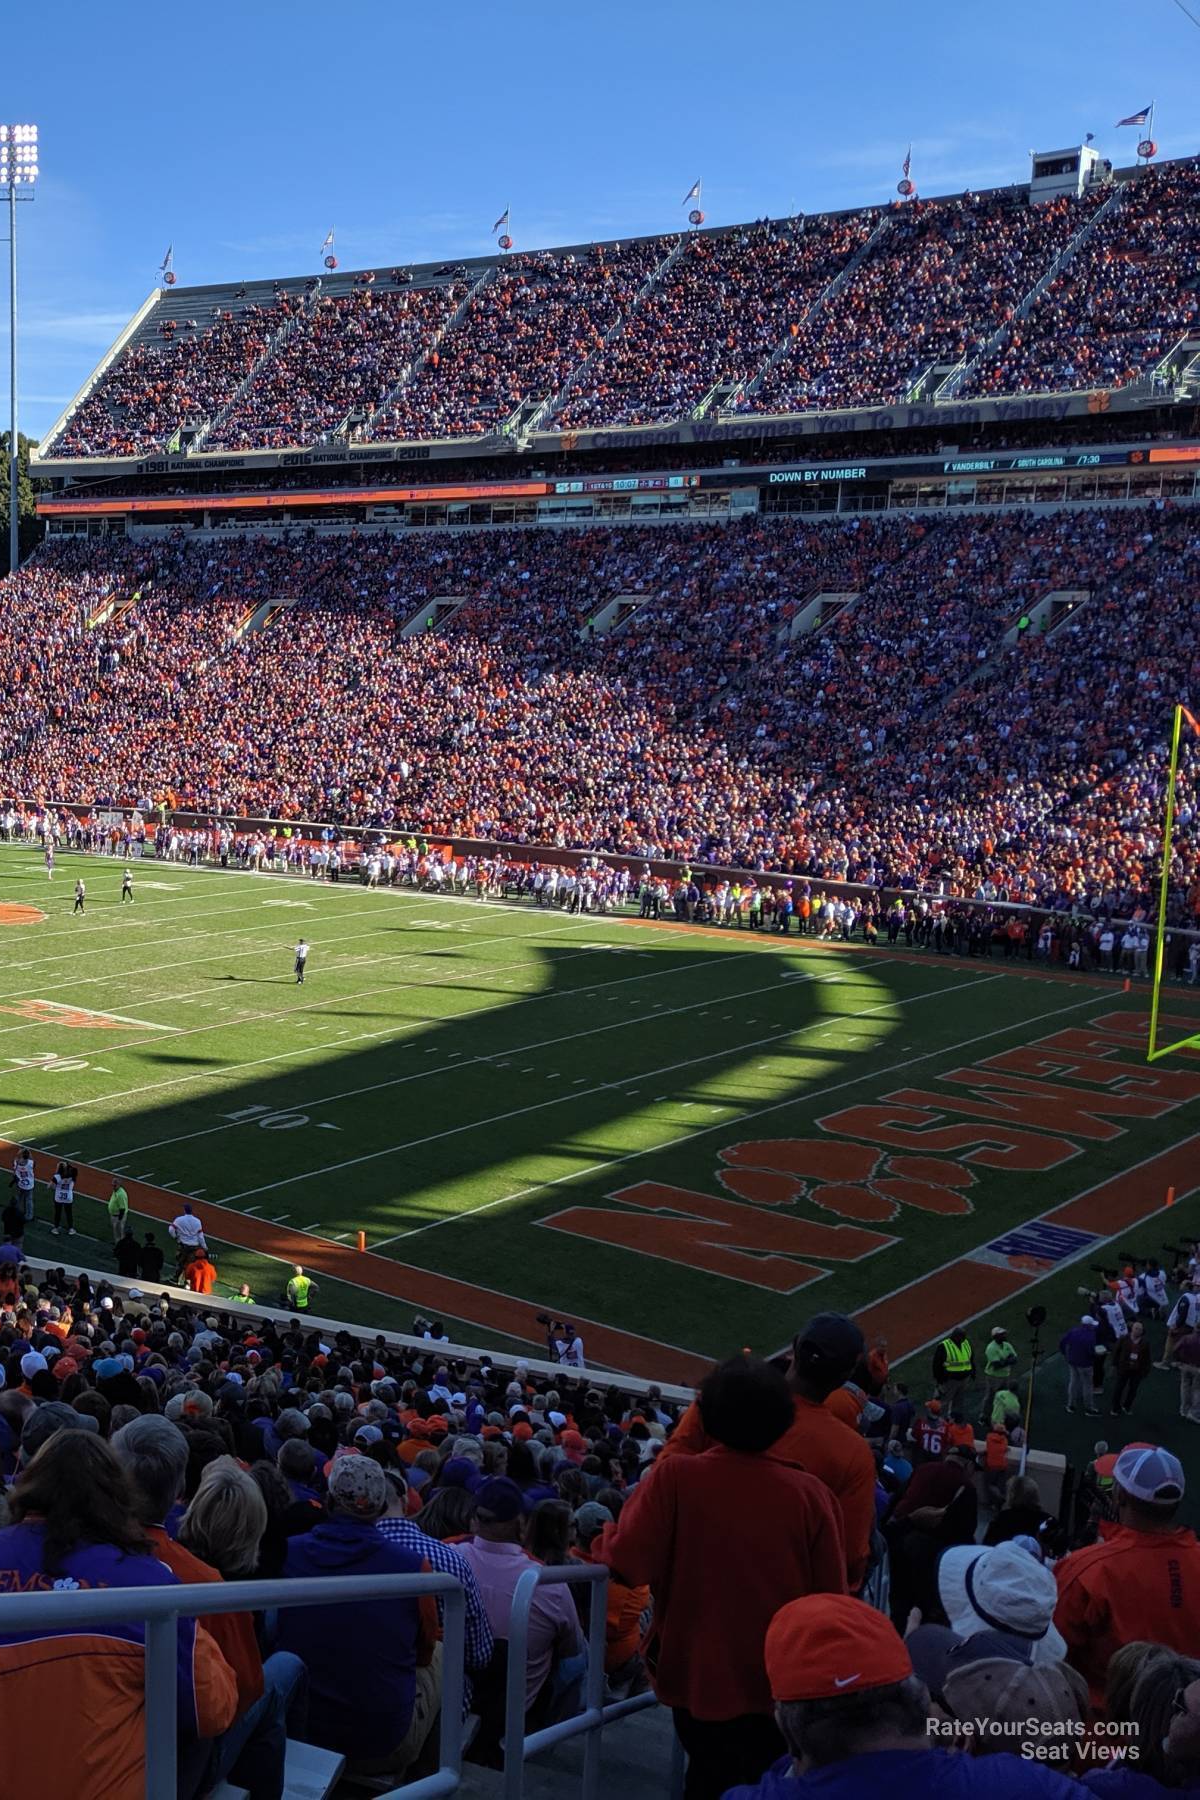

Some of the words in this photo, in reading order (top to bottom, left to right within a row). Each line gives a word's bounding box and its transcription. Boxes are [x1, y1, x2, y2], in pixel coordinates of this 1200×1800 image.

[592, 430, 680, 448] Clemson
[691, 421, 803, 442] Welcomes
[816, 415, 855, 433] You
[867, 412, 894, 429] To
[907, 404, 980, 426] Death
[993, 399, 1071, 421] Valley
[313, 453, 347, 462] NATIONAL
[350, 451, 392, 461] CHAMPIONS
[1017, 458, 1036, 468] SOUTH
[1037, 457, 1064, 467] CAROLINA
[145, 461, 169, 473] 1981
[171, 461, 202, 470] NATIONAL
[204, 458, 245, 468] CHAMPIONS
[952, 461, 994, 471] VANDERBILT
[770, 472, 801, 483] DOWN
[804, 470, 819, 481] BY
[821, 468, 866, 480] NUMBER
[616, 480, 637, 488] 10:07
[4, 1052, 90, 1072] 20
[216, 1104, 310, 1129] 10
[923, 1433, 942, 1454] 16
